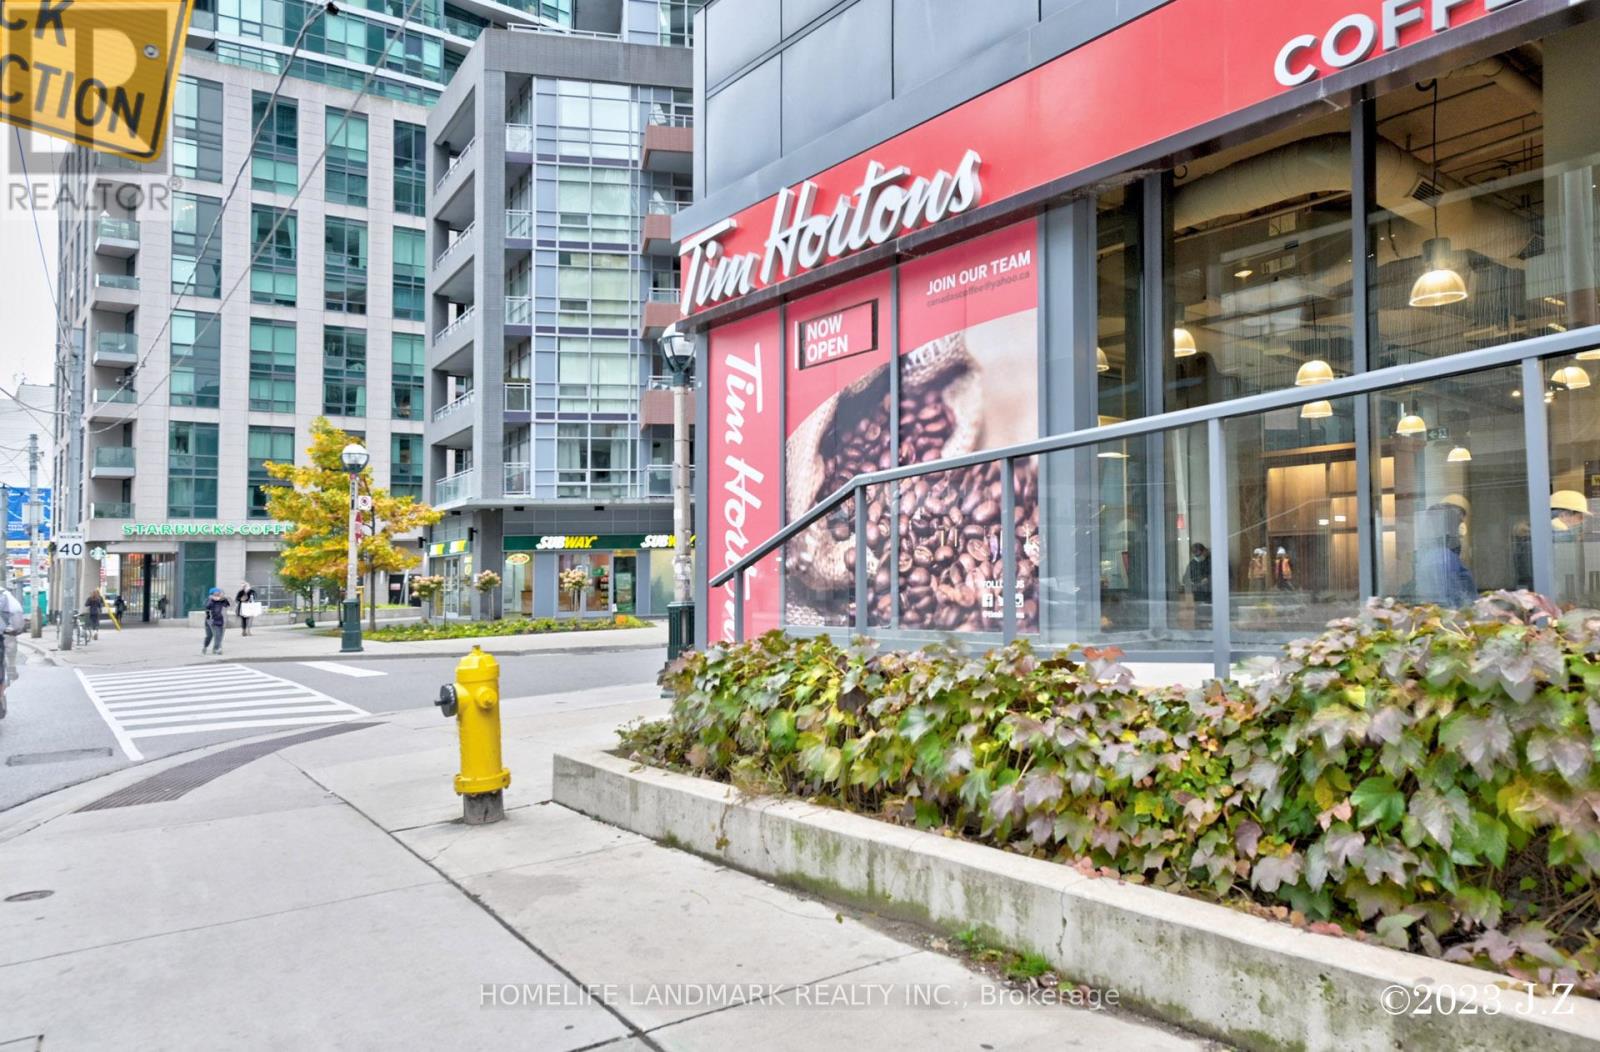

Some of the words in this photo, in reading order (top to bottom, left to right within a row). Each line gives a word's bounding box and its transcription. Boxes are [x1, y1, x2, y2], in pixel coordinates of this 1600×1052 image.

[1274, 0, 1527, 87] COFF
[679, 218, 761, 316] Tim
[760, 149, 982, 285] Hortons
[926, 274, 956, 296] JOIN
[959, 264, 988, 285] OUR
[990, 249, 1031, 275] TEAM
[806, 313, 843, 340] NOW
[806, 334, 849, 363] OPEN
[725, 341, 764, 445] Tim
[122, 522, 236, 536] STARBUCKS
[536, 535, 598, 549] SUBWAY
[59, 543, 82, 556] 40
